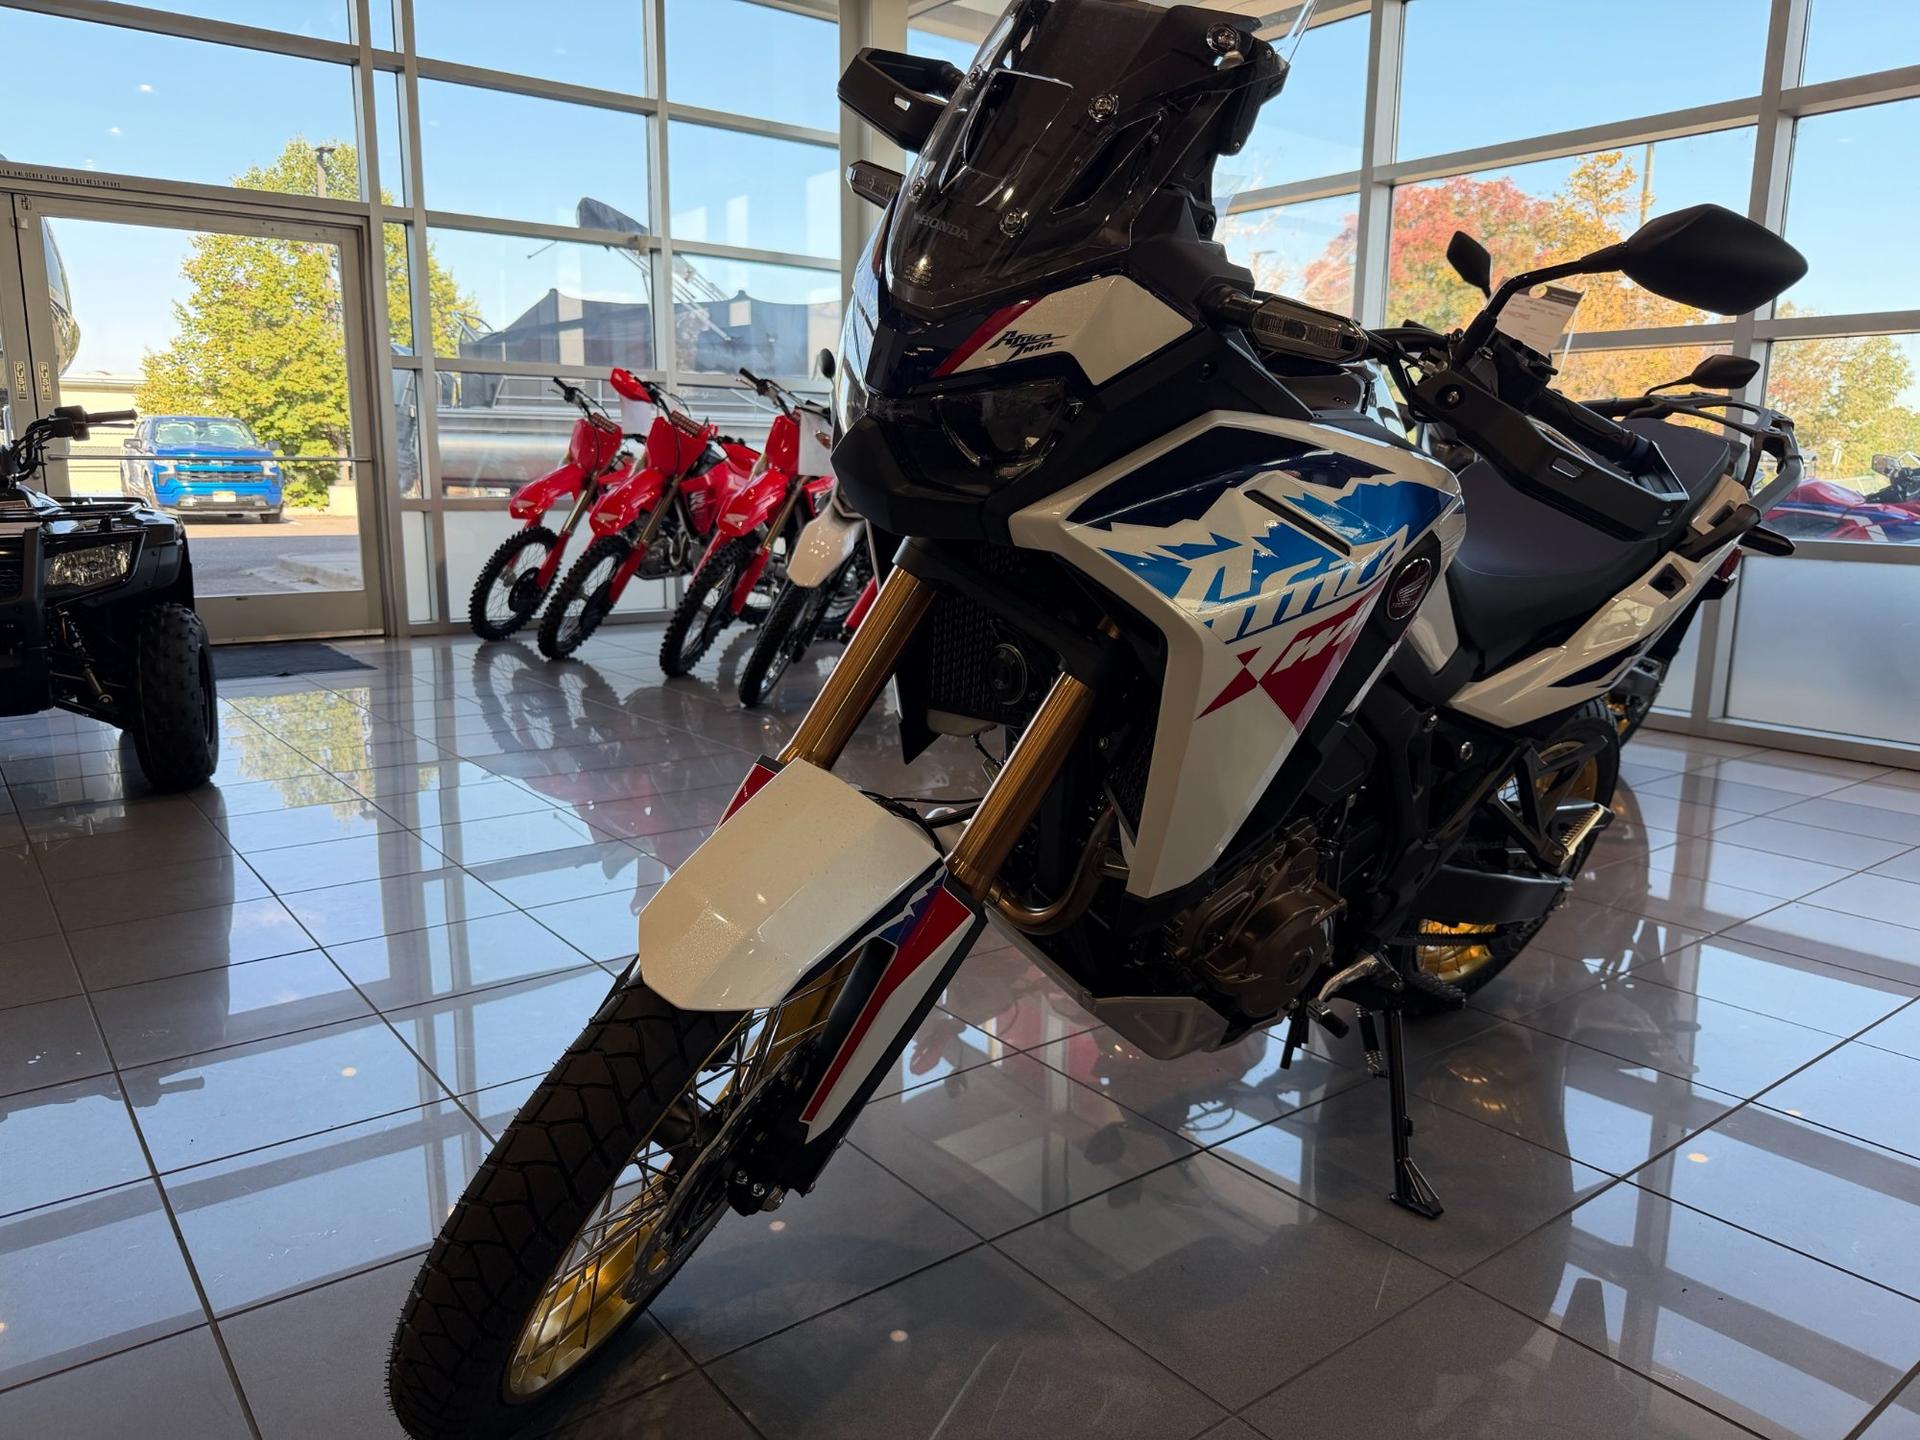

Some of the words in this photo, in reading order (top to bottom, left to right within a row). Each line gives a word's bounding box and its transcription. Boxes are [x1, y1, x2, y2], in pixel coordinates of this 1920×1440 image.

[917, 214, 969, 240] HONDA
[985, 330, 1071, 351] Africa
[1007, 341, 1061, 361] Twin
[16, 364, 26, 391] PUSH
[40, 364, 50, 392] PUSH
